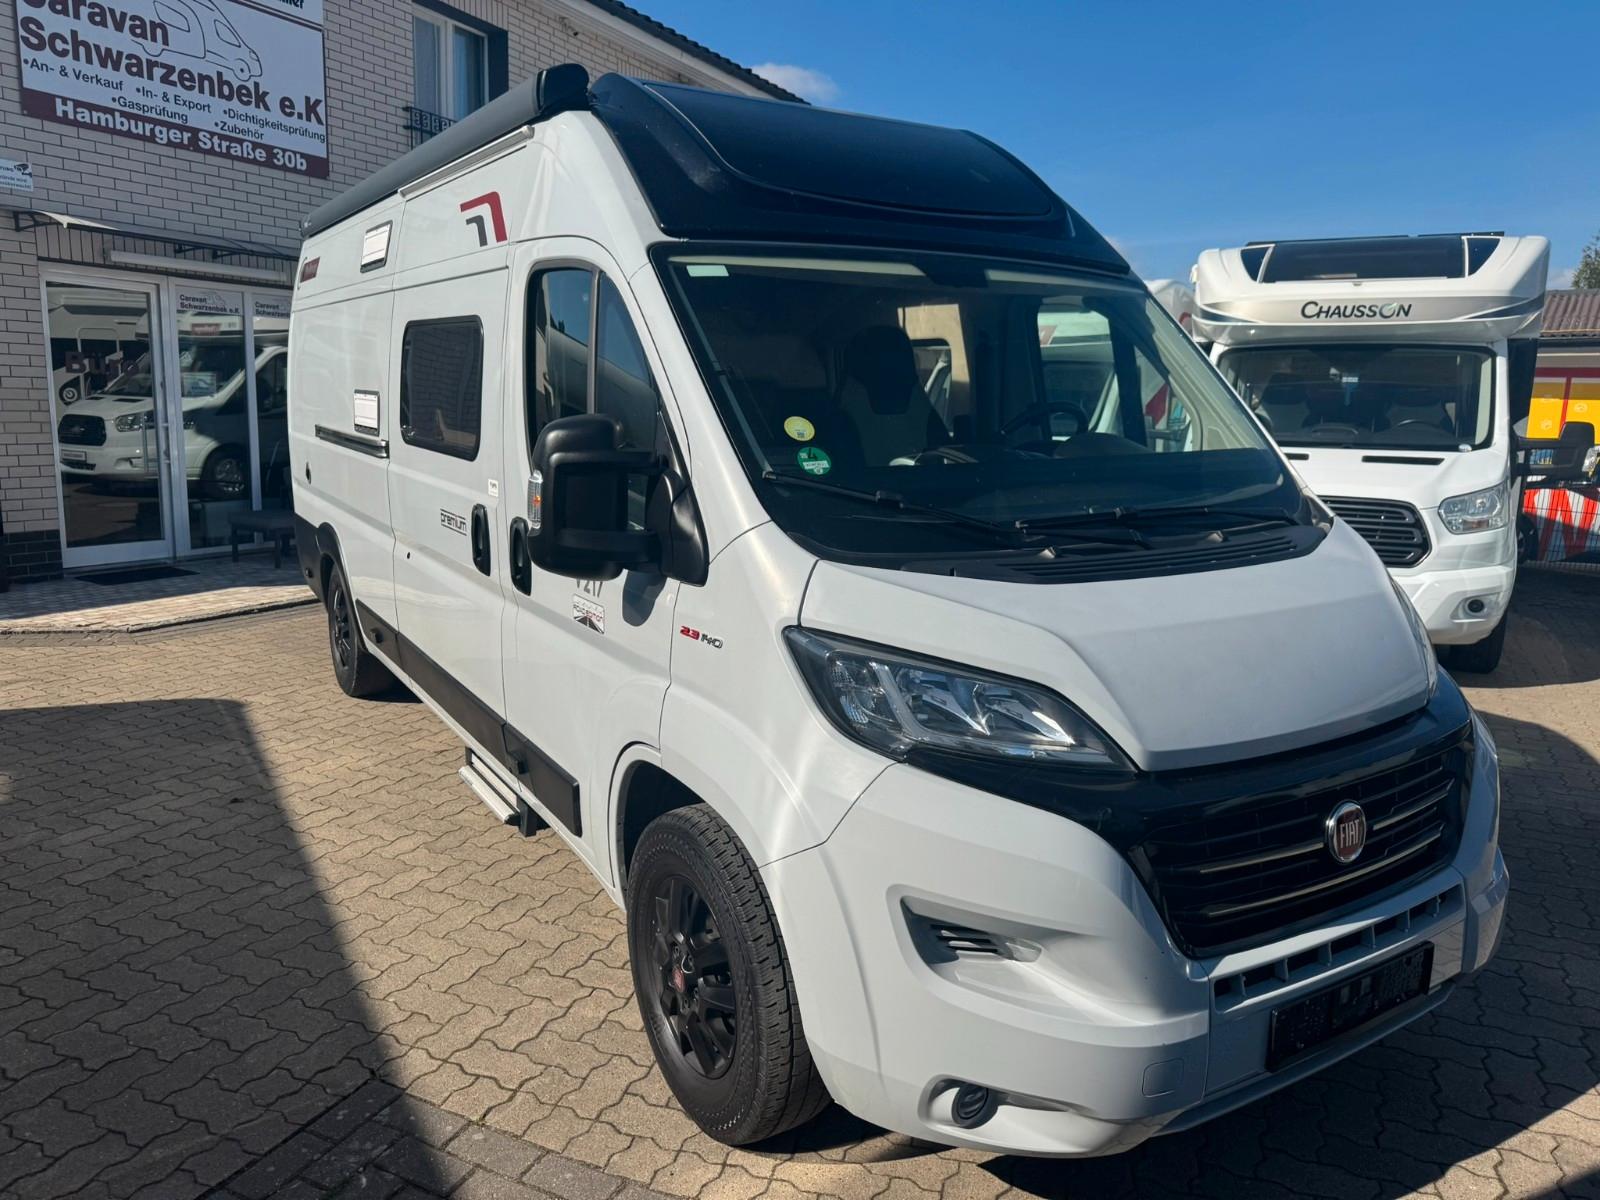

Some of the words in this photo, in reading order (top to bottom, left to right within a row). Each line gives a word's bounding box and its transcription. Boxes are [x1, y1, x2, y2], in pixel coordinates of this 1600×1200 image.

[22, 0, 169, 46] aravan
[20, 15, 271, 113] Schwarzenbek
[59, 65, 69, 78] &
[72, 67, 124, 92] Verkauf
[117, 96, 188, 125] Gasprüfung
[161, 91, 170, 104] &
[173, 94, 212, 114] Export
[55, 97, 192, 146] Hamburger
[198, 130, 267, 162] Straße
[272, 147, 307, 172] 30b
[219, 120, 265, 140] Zubehör
[227, 108, 326, 144] Dichtigkeitsprüfung
[1300, 300, 1412, 319] CHAUSSON
[1339, 819, 1360, 849] FIAT
